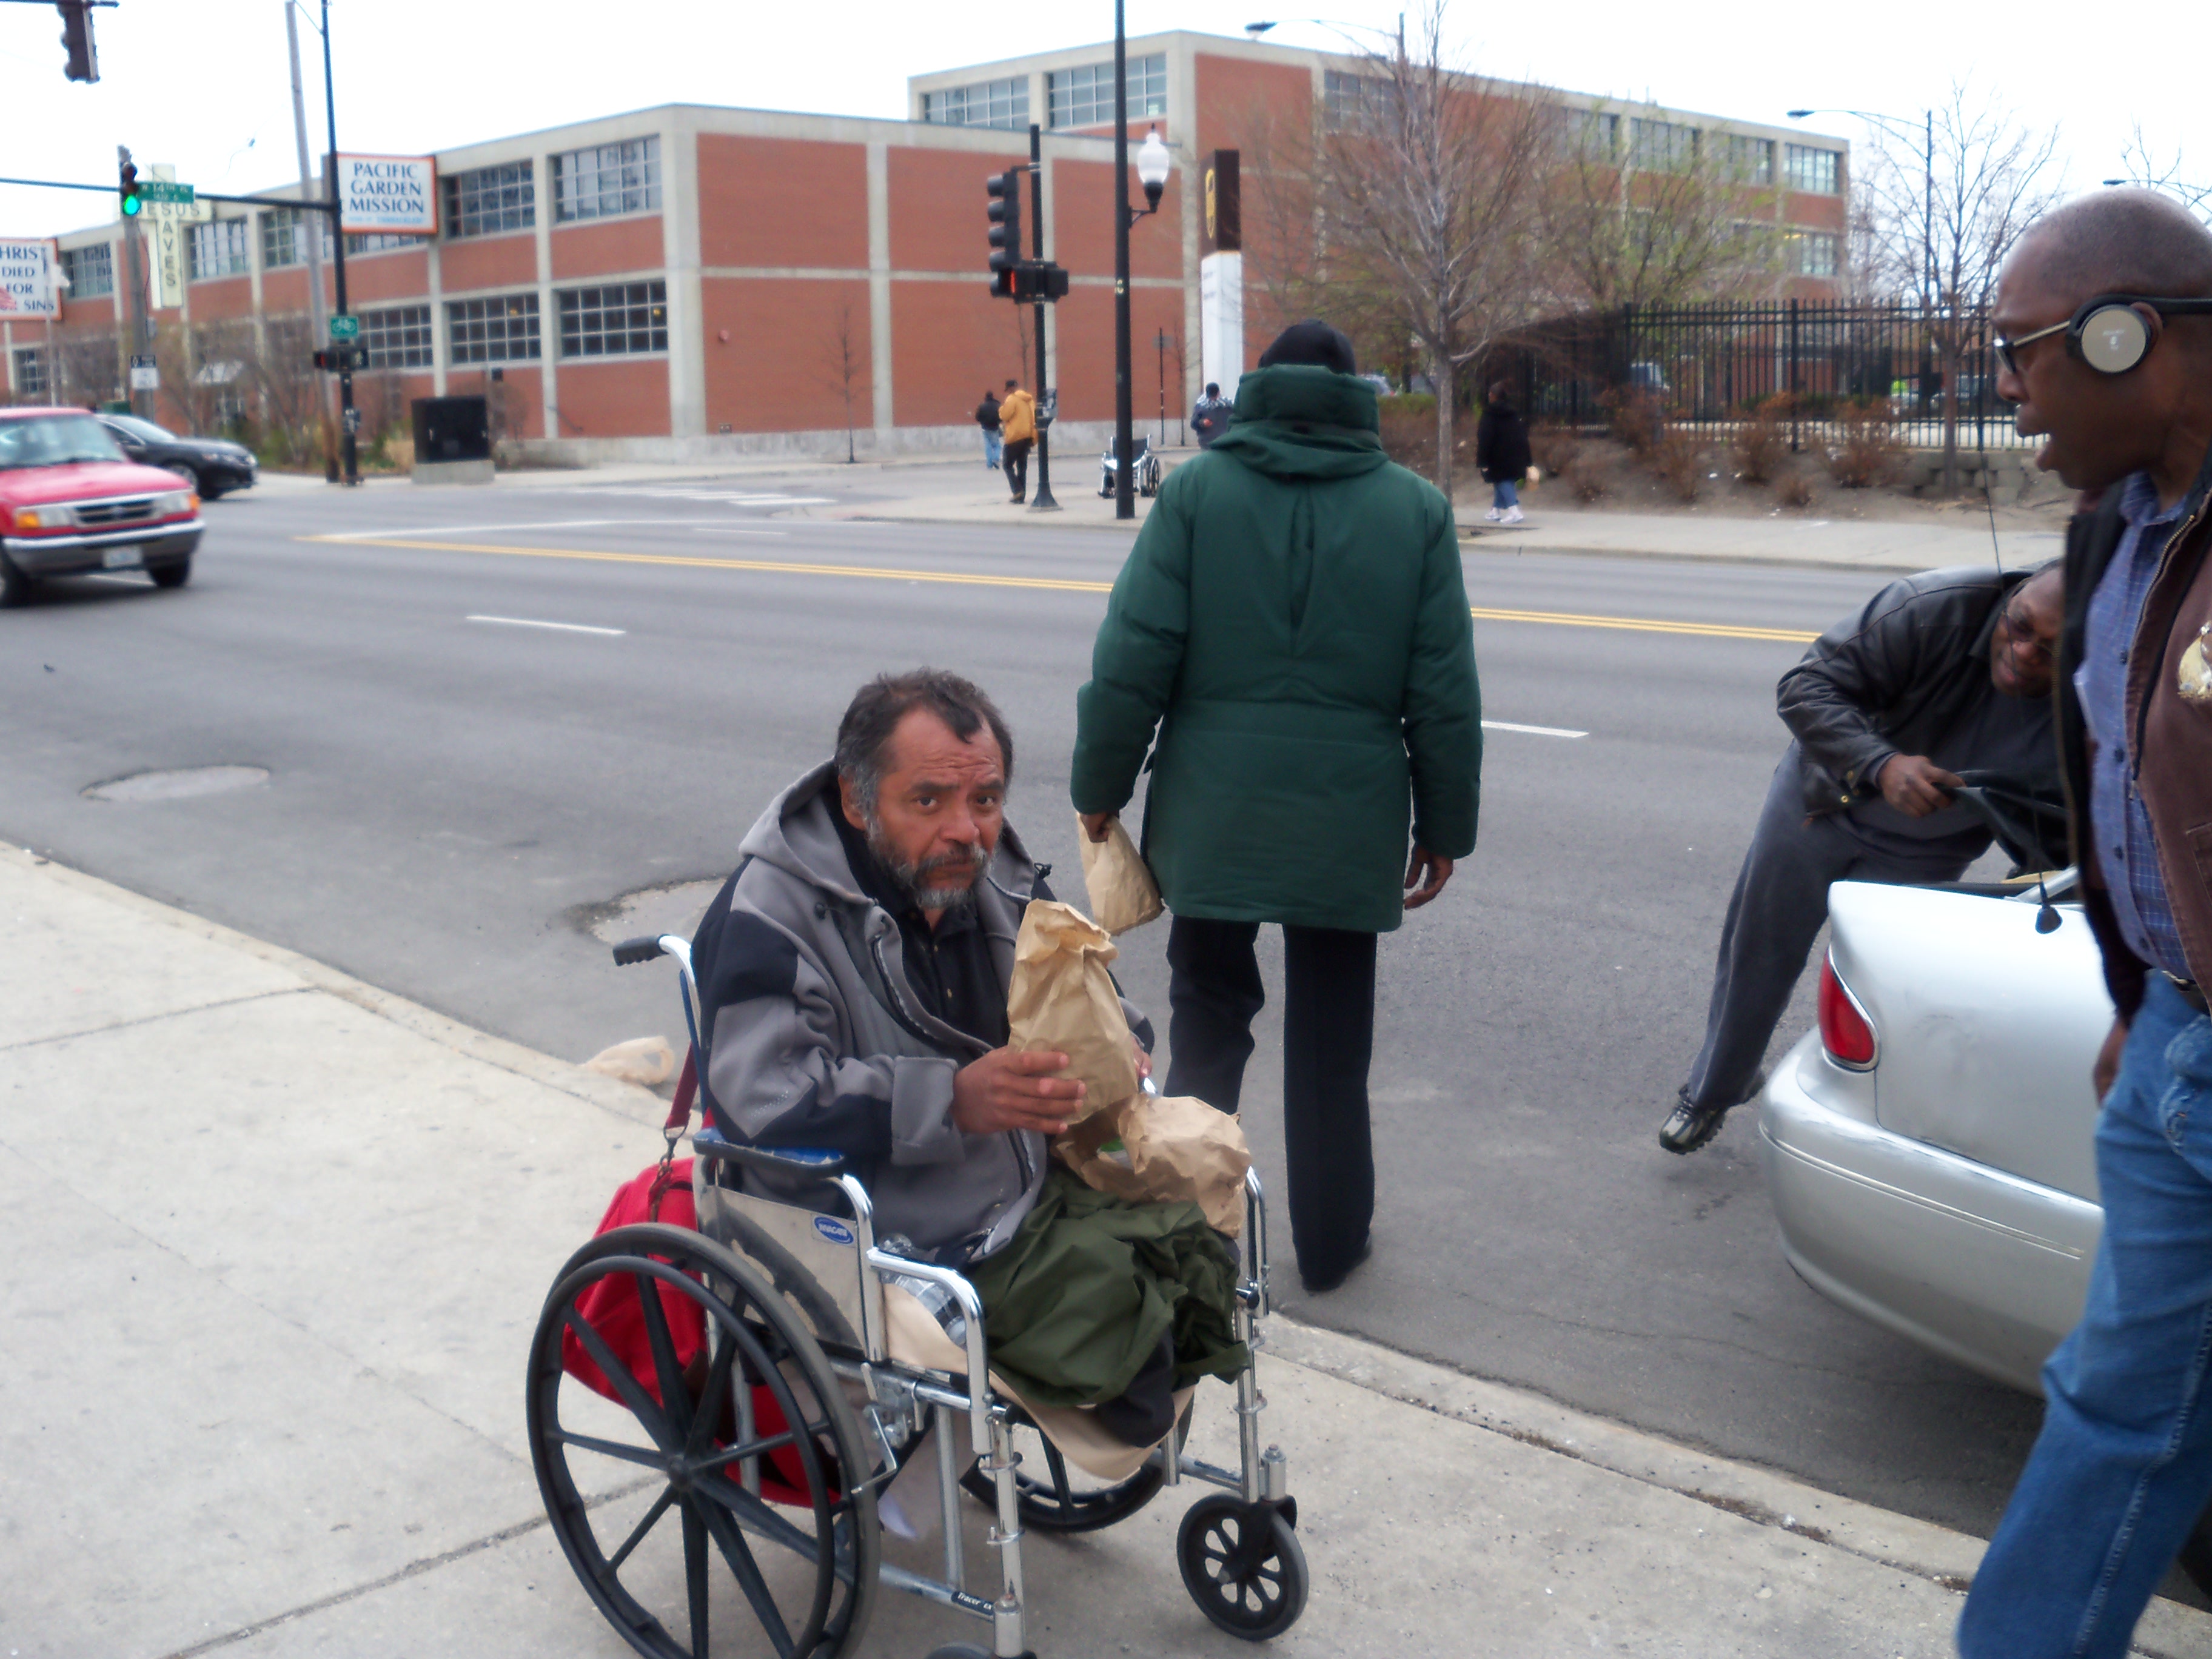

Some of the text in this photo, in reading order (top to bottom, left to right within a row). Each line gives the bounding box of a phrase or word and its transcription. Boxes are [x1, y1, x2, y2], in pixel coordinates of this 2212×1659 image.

[354, 162, 418, 179] PACIFIC
[350, 179, 421, 196] GARDEN
[349, 197, 423, 213] MISSION
[2, 266, 35, 277] DIED
[6, 283, 33, 294] FOR
[24, 300, 55, 310] SINS
